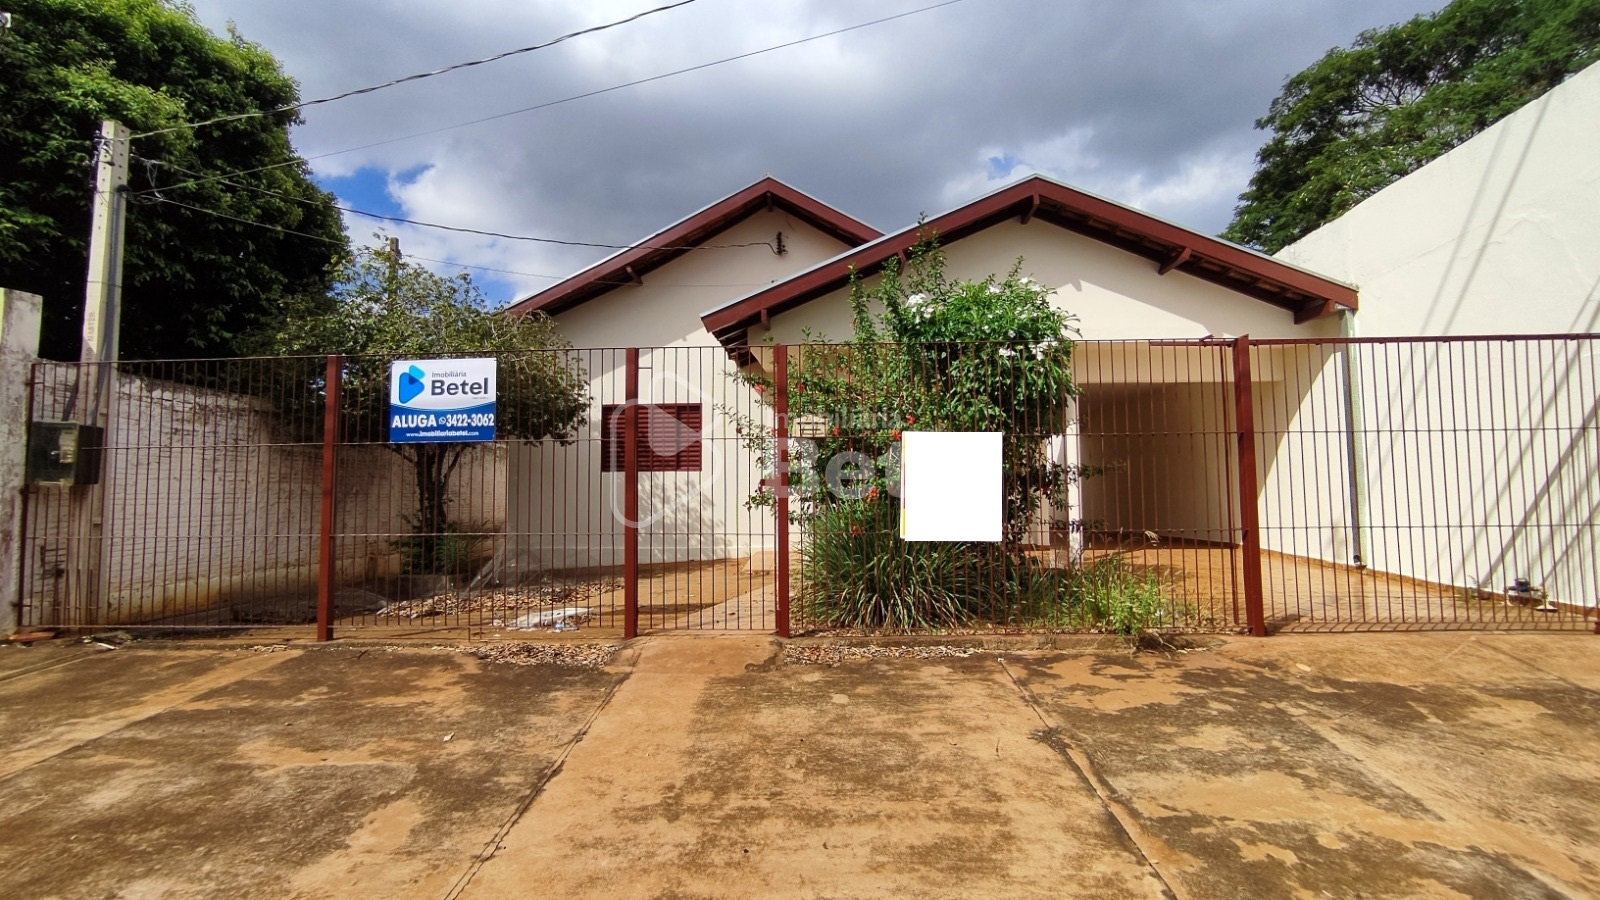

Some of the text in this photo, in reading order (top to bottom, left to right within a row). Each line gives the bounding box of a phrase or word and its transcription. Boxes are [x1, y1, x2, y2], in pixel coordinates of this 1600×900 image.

[431, 377, 488, 396] Betel
[392, 414, 494, 428] ALUGA 3422-3062
